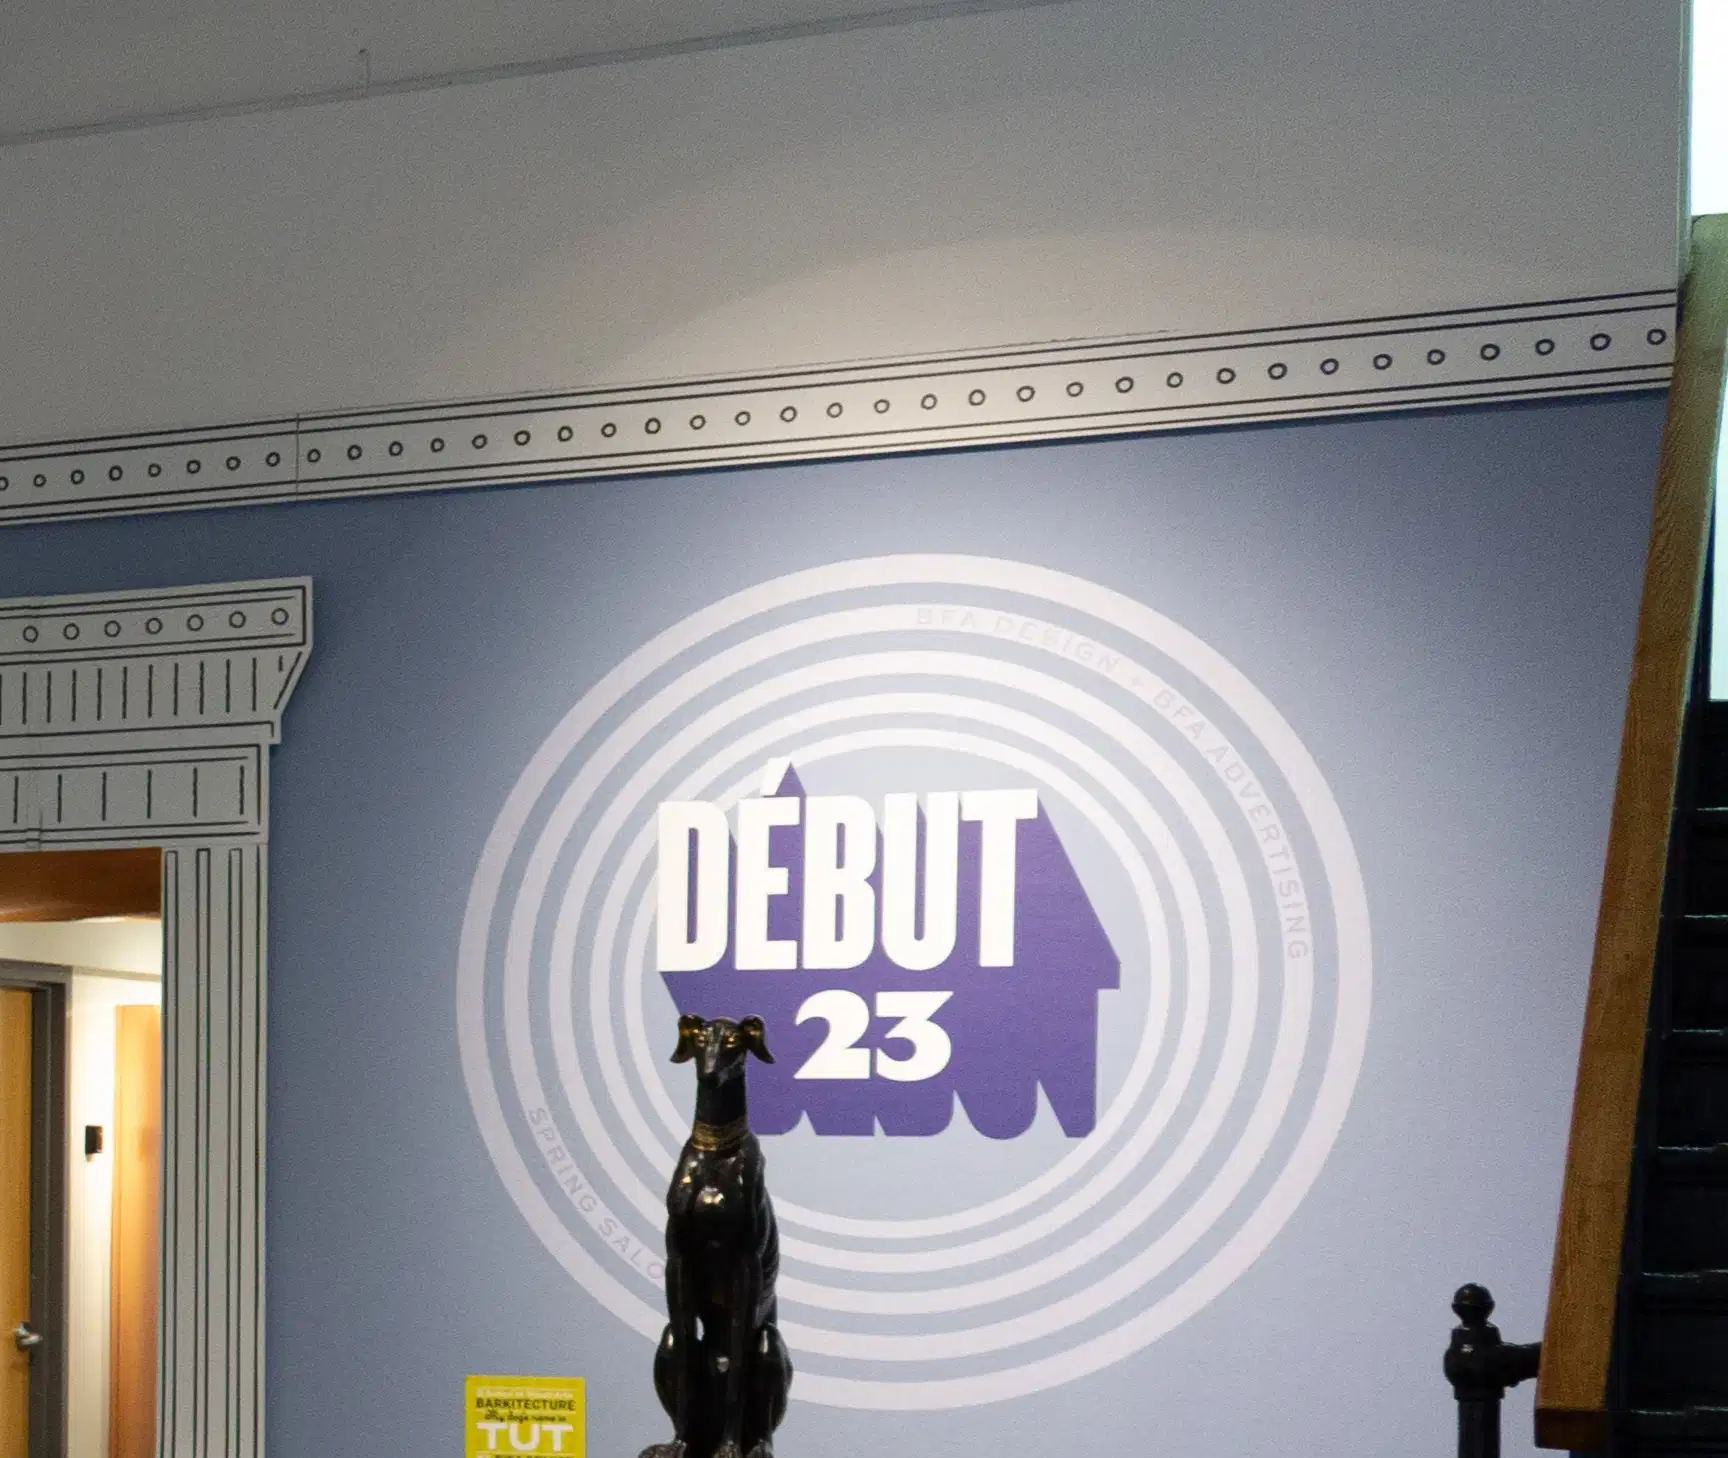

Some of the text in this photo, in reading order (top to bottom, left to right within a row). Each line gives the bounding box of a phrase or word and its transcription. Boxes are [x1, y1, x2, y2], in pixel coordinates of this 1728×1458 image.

[916, 608, 1310, 961] BFA DESIGN BFA ADVERTISING
[656, 757, 1039, 972] DÉBUT
[794, 988, 954, 1082] 23
[527, 1107, 665, 1280] SPRING SALO
[476, 1397, 576, 1412] BARKITECTURE
[476, 1421, 574, 1453] TUT
